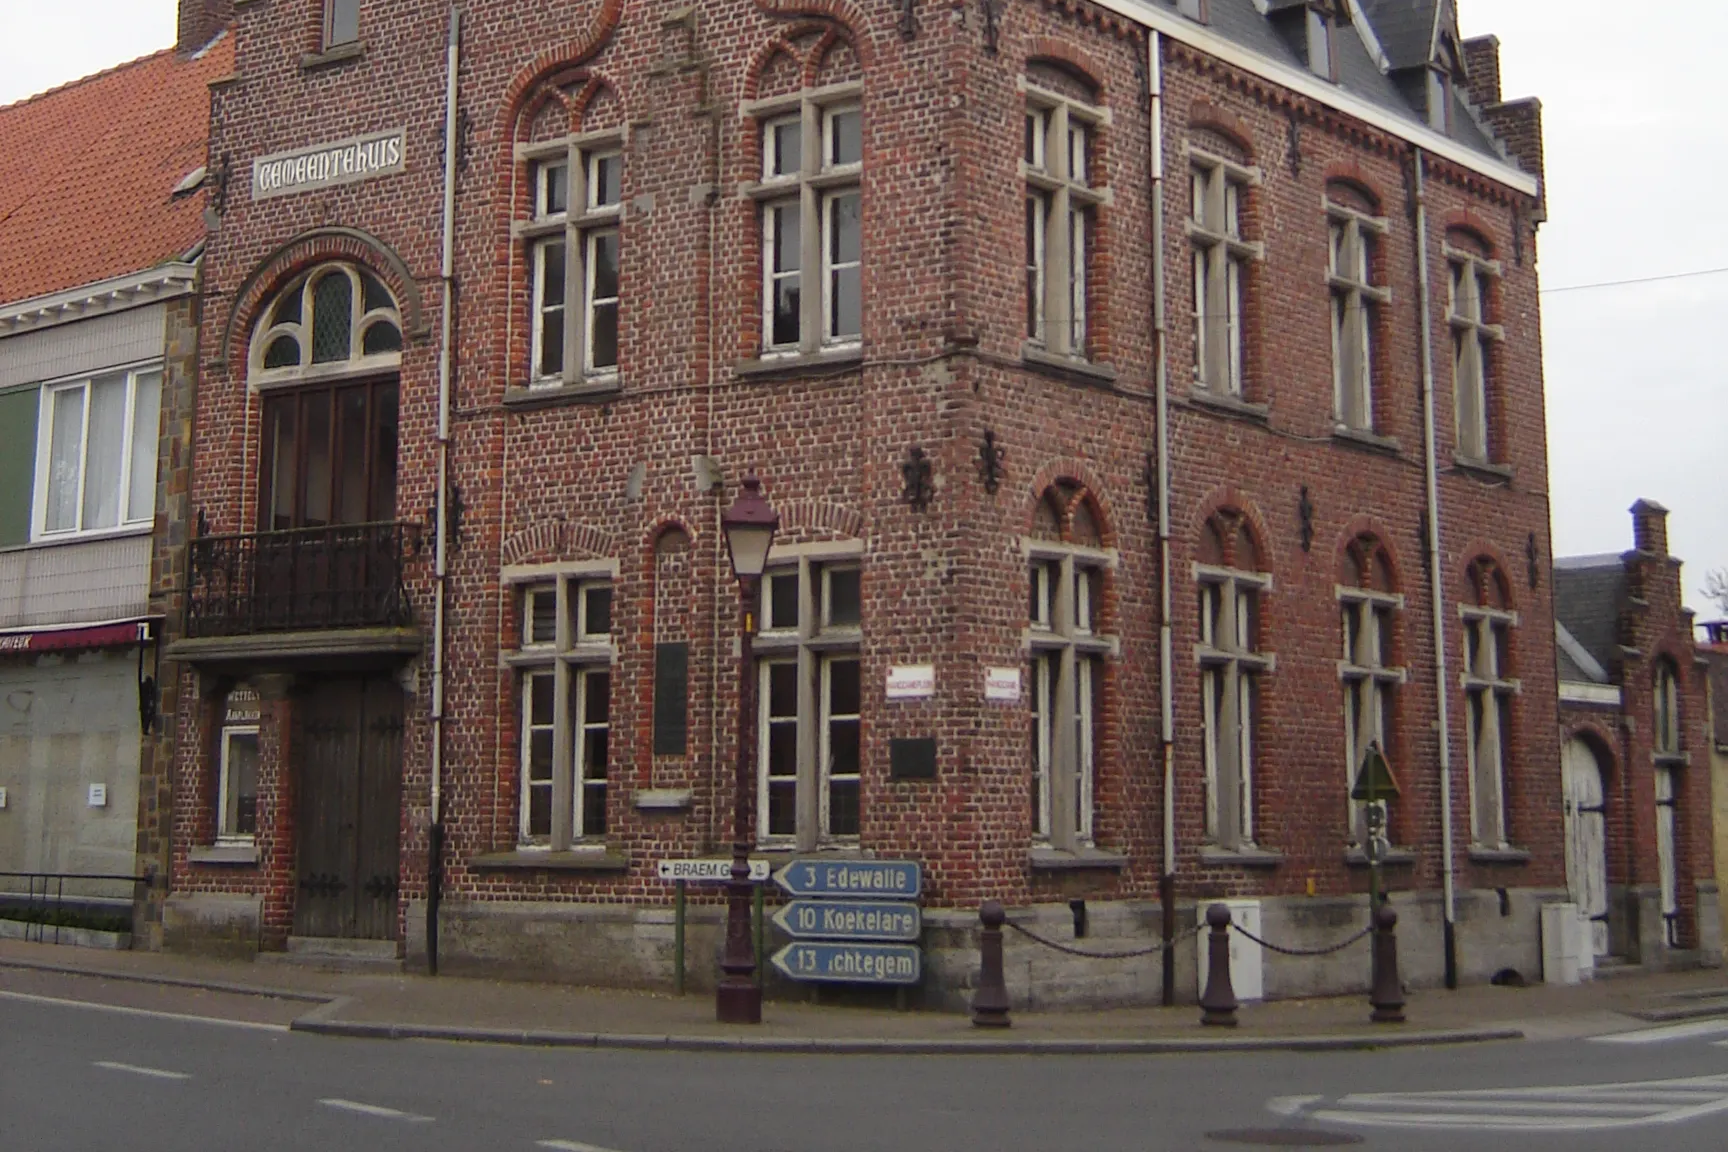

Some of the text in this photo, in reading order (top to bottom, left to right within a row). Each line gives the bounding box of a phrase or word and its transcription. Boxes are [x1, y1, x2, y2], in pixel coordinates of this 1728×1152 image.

[673, 863, 717, 876] BRAEM
[804, 867, 906, 889] 3 Edewalle
[797, 908, 913, 931] 10 Koekelare
[797, 949, 816, 970] 13
